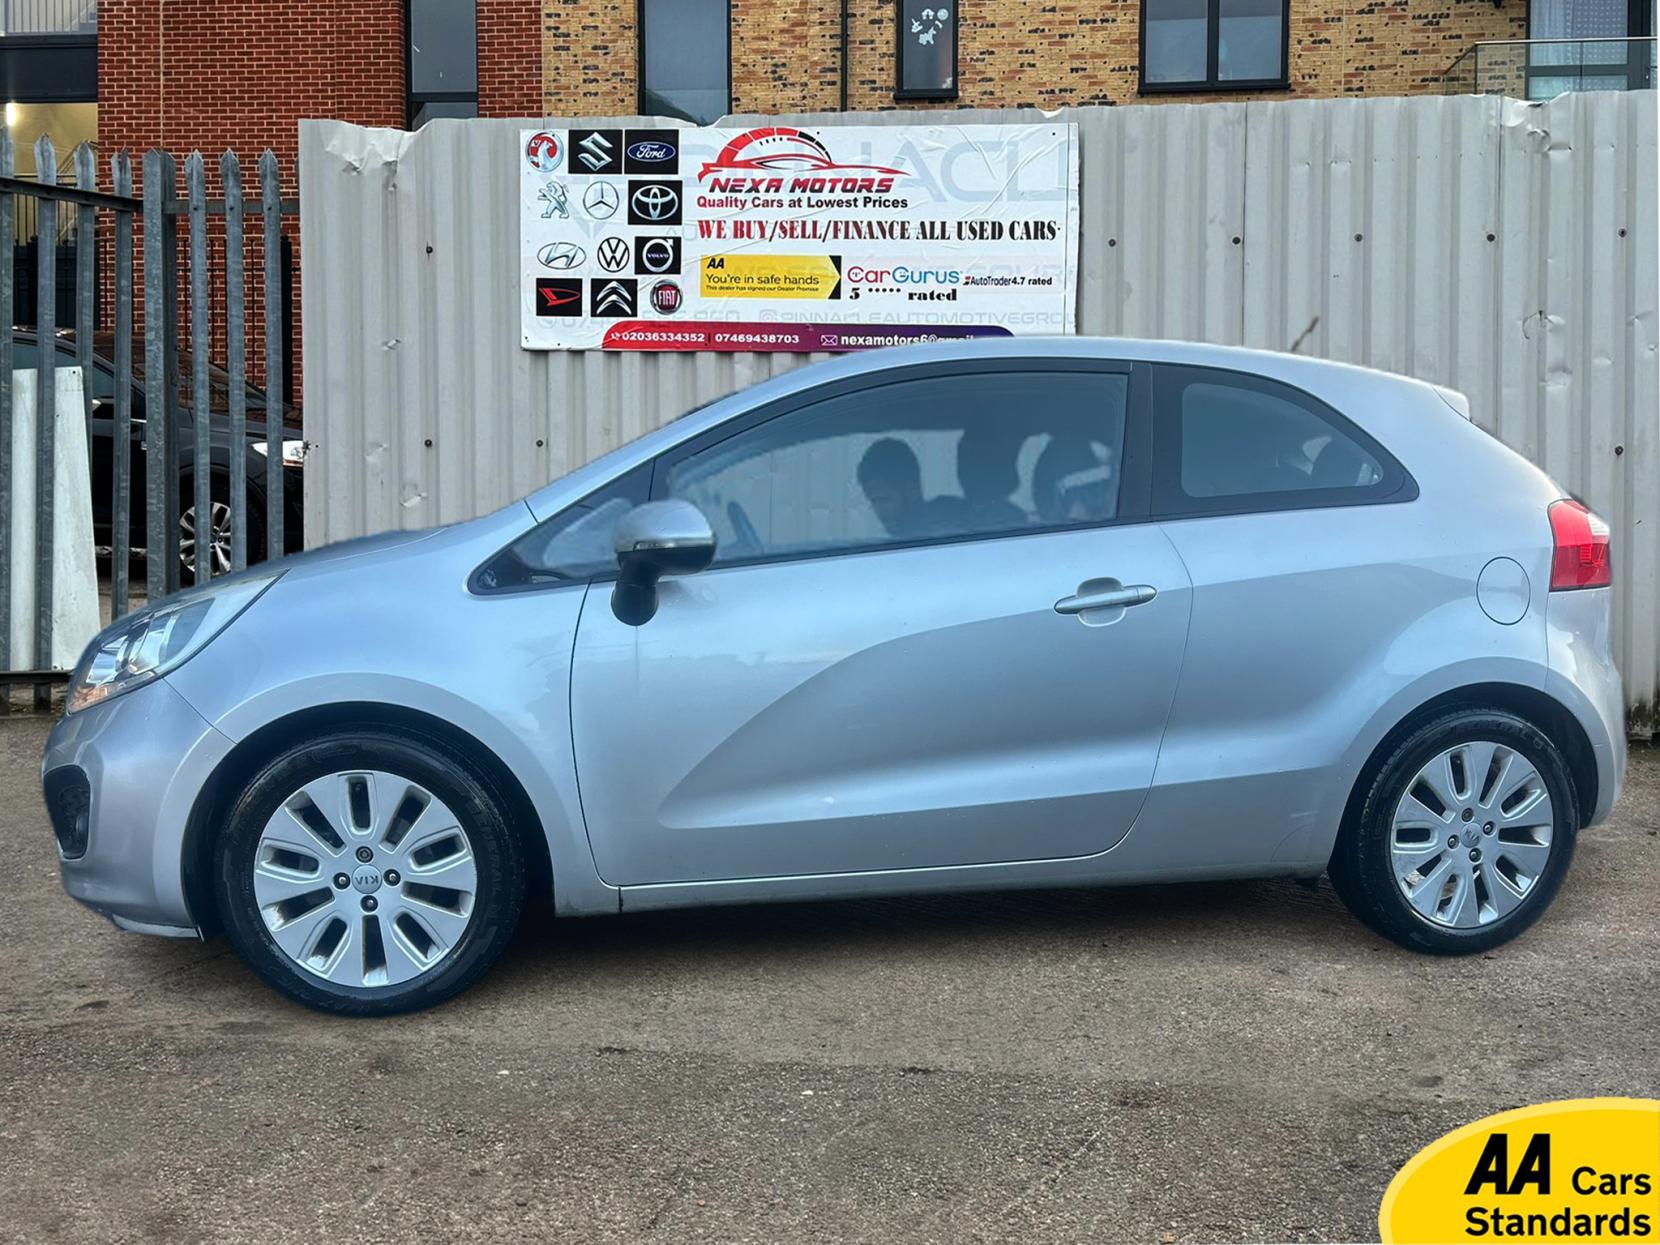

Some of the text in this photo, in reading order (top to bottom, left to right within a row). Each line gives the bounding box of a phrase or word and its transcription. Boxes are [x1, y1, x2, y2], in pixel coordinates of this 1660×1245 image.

[636, 144, 666, 159] Ford
[708, 177, 895, 193] NEXA MOTORS
[696, 196, 908, 211] Quality Cars at Lowest Prices
[697, 219, 727, 240] WE
[733, 219, 911, 243] BUY/SELL/FINANCE
[916, 220, 951, 240] ALL
[956, 220, 1004, 240] USED
[1008, 220, 1057, 240] CARS
[706, 257, 725, 269] AA
[706, 273, 820, 285] You're in safe hands
[847, 265, 960, 284] CarGurus
[1028, 277, 1053, 285] rated
[658, 290, 676, 305] FIAT
[849, 287, 957, 301] 5 rated
[622, 332, 705, 342] 02036334352
[715, 334, 800, 344] 07469438703
[355, 875, 379, 885] KIA
